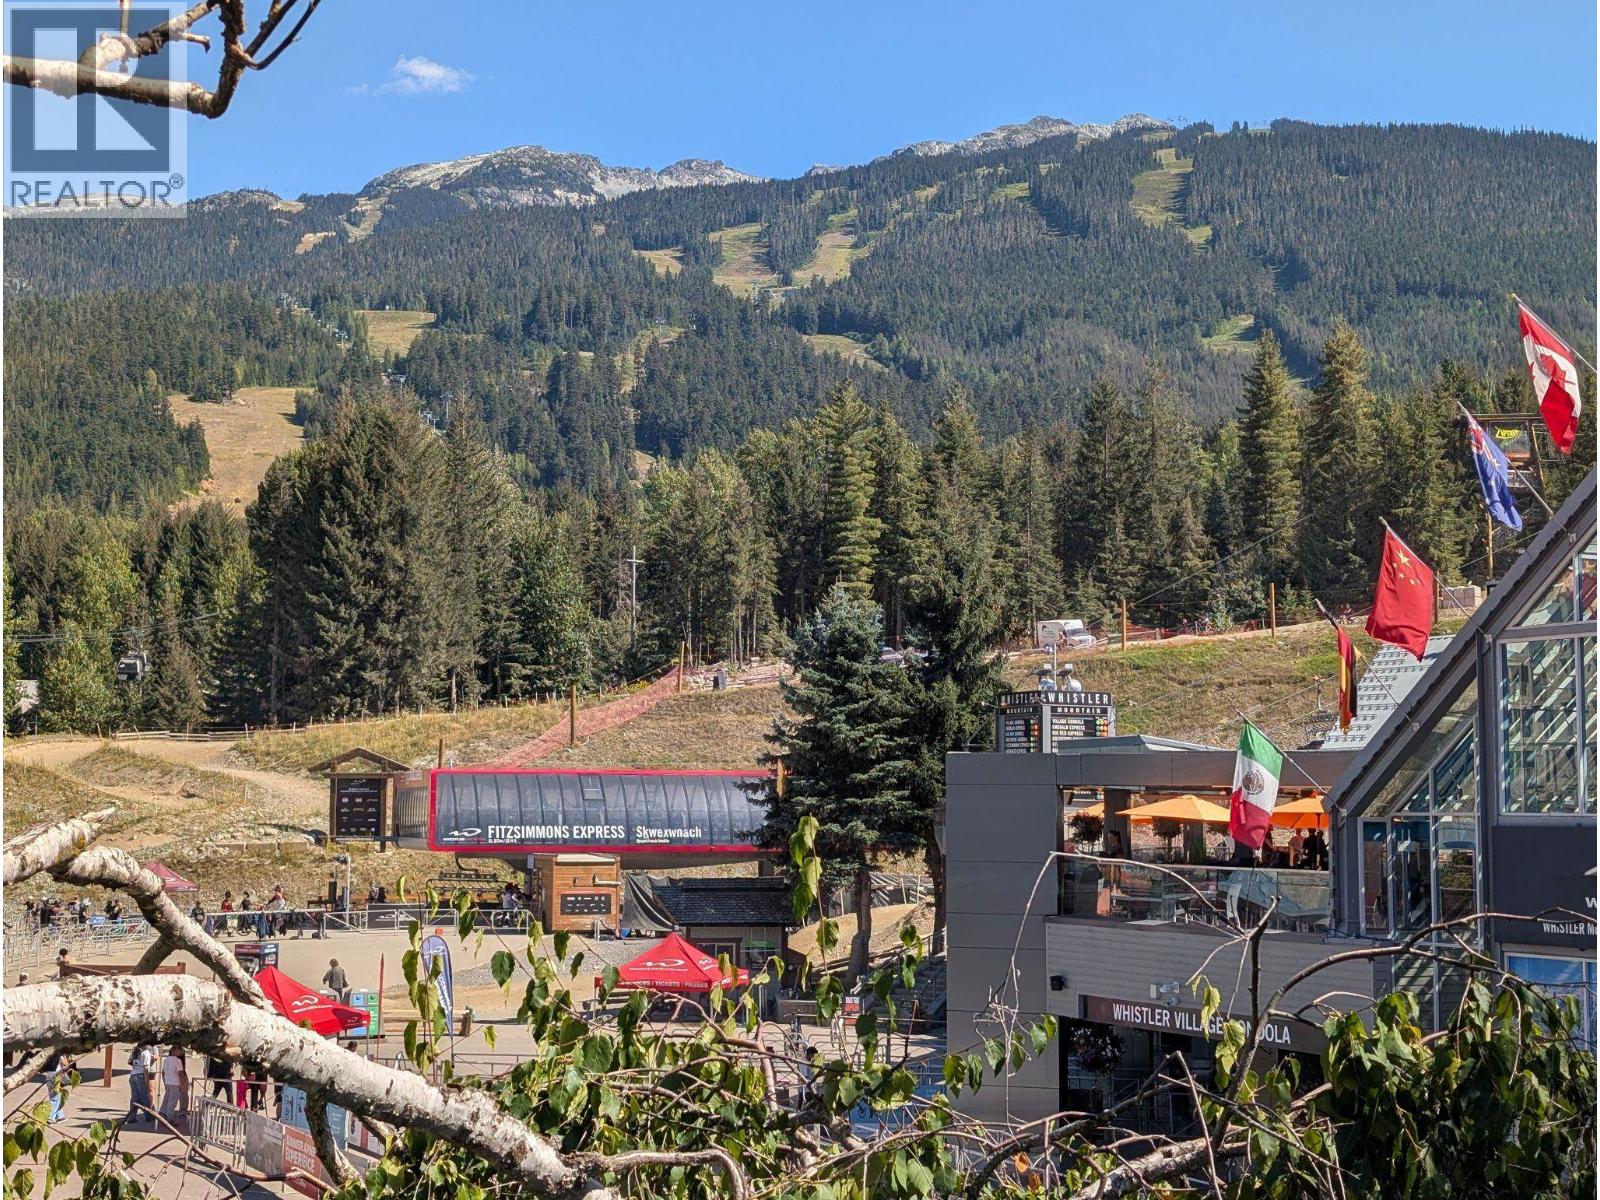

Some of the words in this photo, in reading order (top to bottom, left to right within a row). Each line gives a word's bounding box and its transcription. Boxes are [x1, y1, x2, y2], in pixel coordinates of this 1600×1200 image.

[1048, 692, 1109, 705] WHISTLER
[1057, 706, 1101, 714] MOUNTAIN
[487, 825, 570, 839] FITZSIMMONS
[573, 825, 625, 839] EXPRESS
[1542, 921, 1585, 935] WHISTLER
[655, 980, 681, 988] TICKETS
[684, 981, 709, 989] PASSES
[1113, 1003, 1170, 1028] WHISTLER
[1174, 1010, 1224, 1035] VILLGE
[1228, 1018, 1291, 1045] ONOLA
